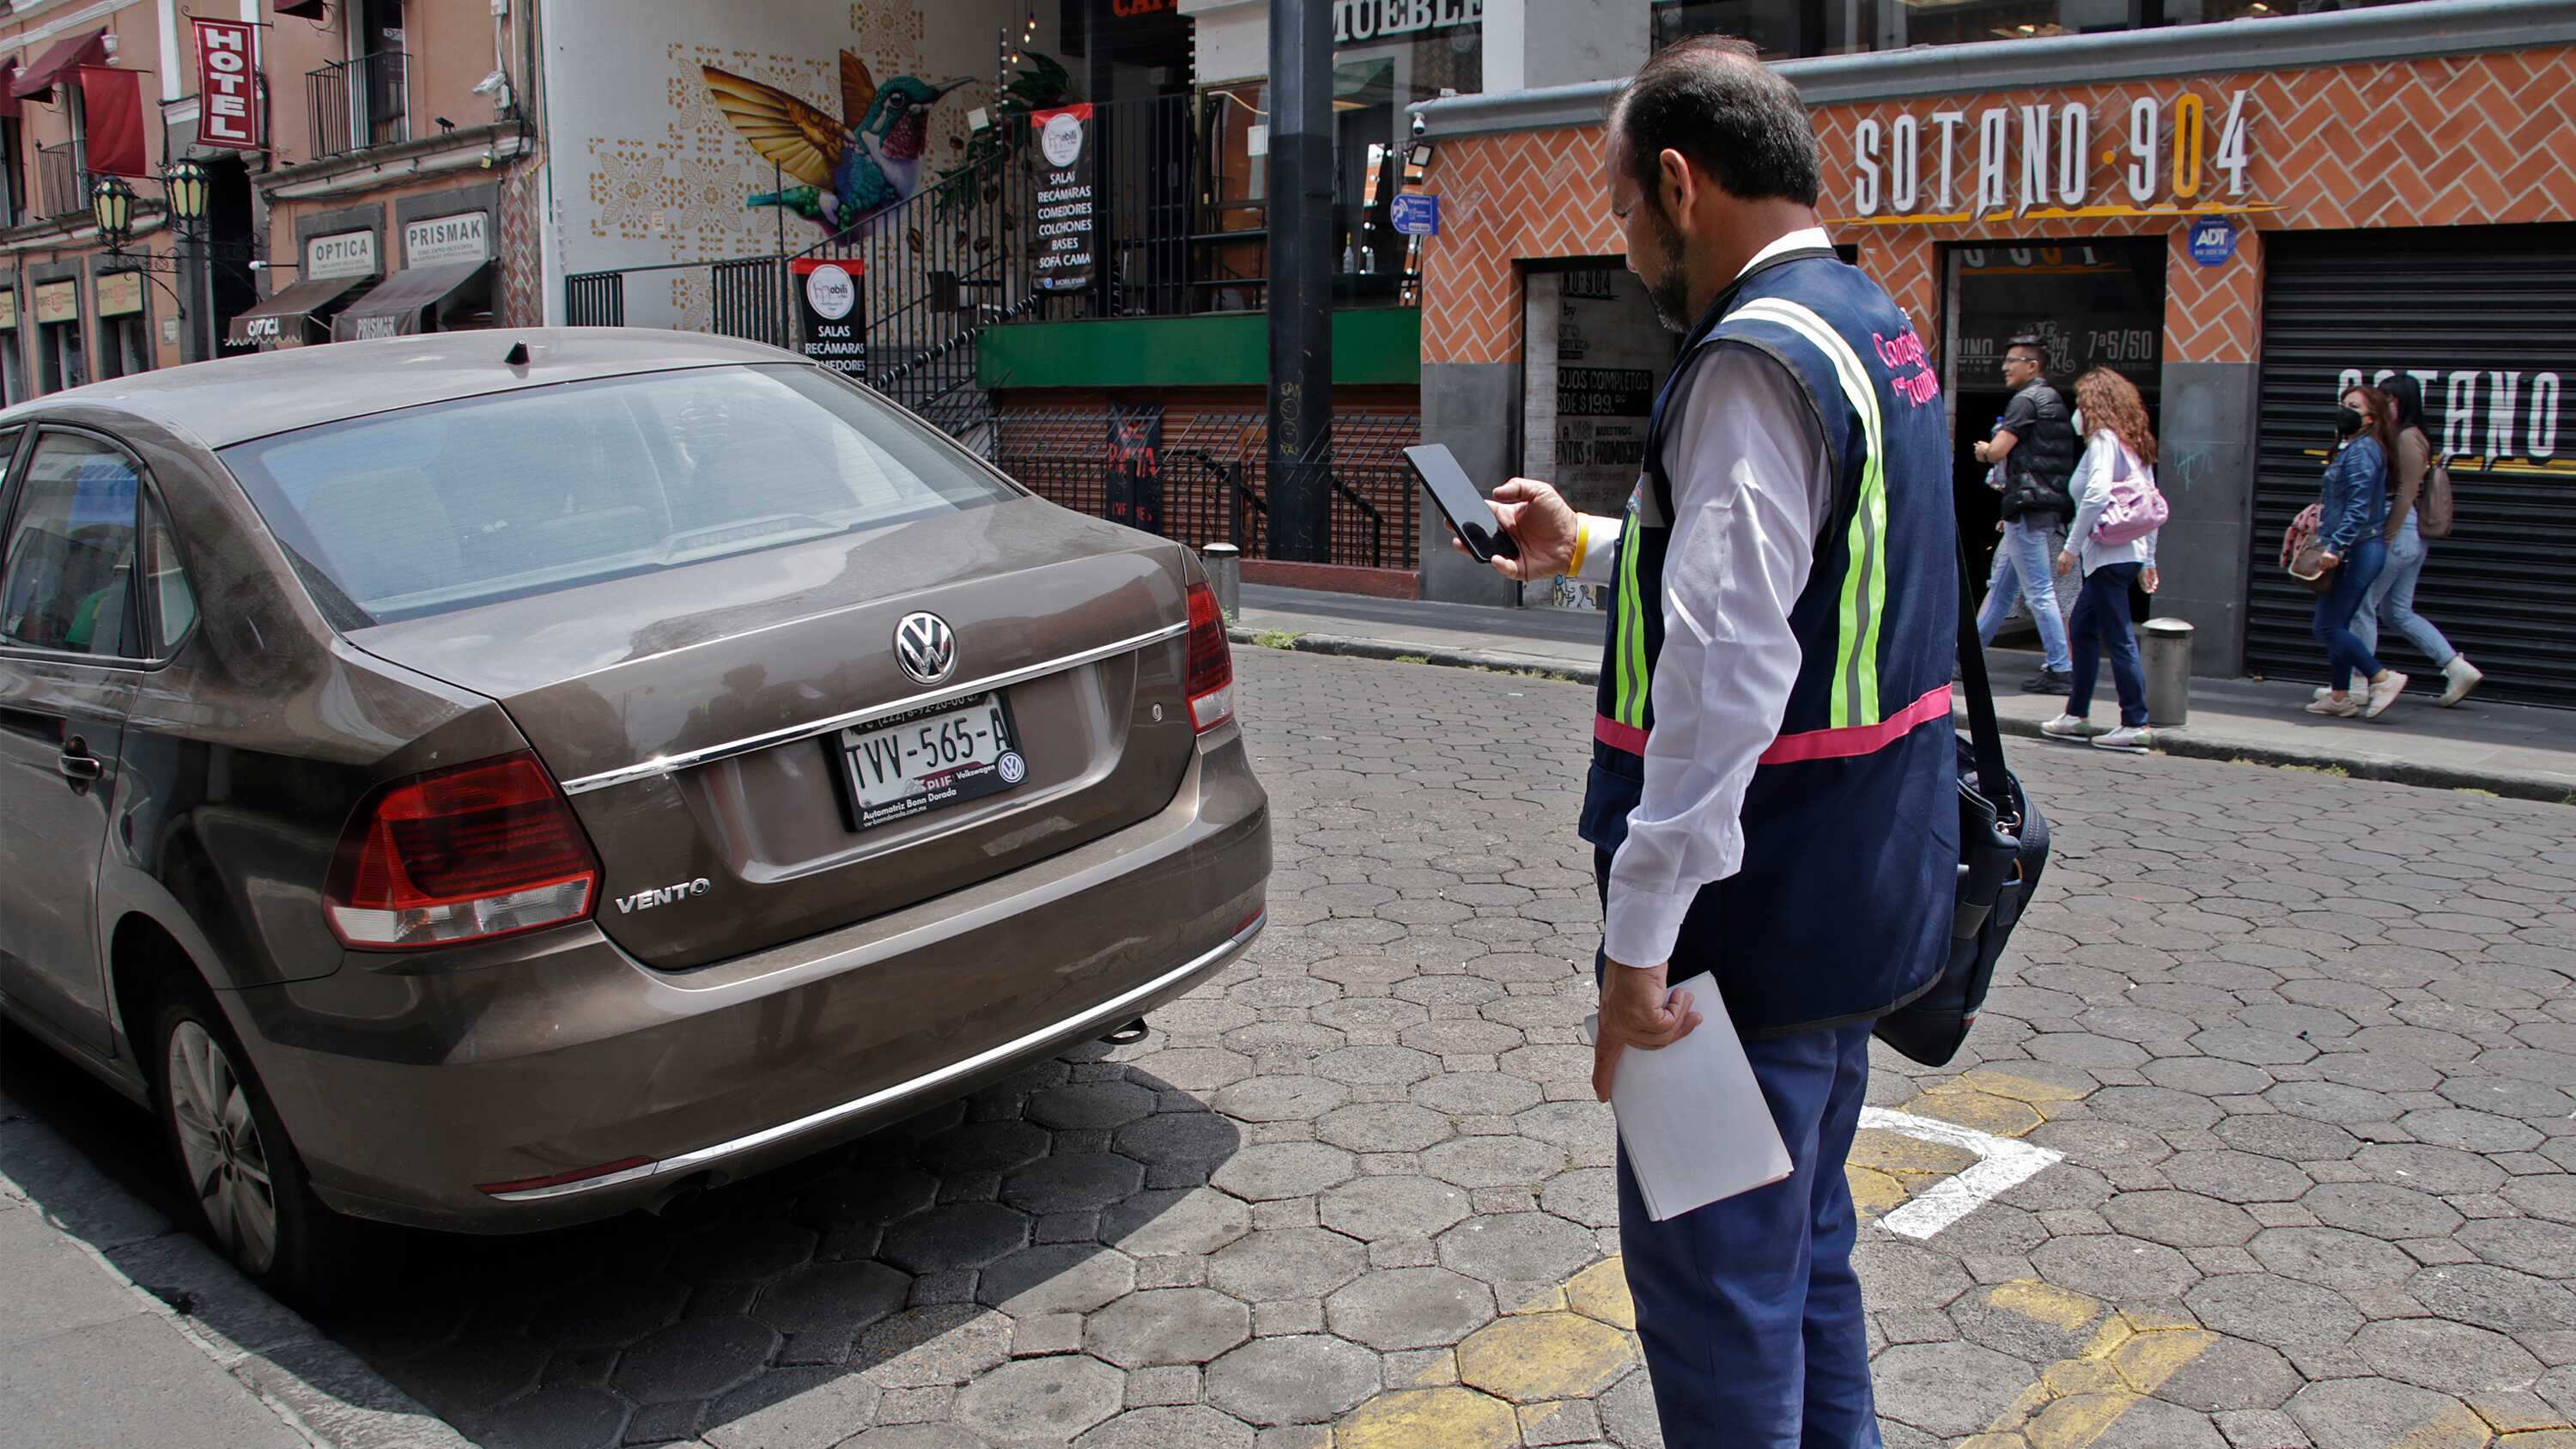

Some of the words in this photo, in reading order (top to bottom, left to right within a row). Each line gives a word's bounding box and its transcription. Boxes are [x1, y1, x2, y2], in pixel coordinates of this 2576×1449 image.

[204, 27, 246, 139] HOTEL
[1855, 100, 2088, 220] SOTANO
[2129, 90, 2248, 202] 904
[1050, 171, 1076, 185] SALAS
[1037, 202, 1092, 220] COMEDORES
[410, 219, 482, 247] PRISMAK
[1038, 219, 1092, 235] COLCHONES
[1051, 237, 1078, 251] BASES
[2196, 228, 2228, 247] ADT
[316, 239, 368, 261] OPTICA
[1039, 253, 1062, 269] SOFÁ
[1063, 253, 1091, 266] CAMA
[818, 326, 851, 338] SALAS
[805, 341, 865, 355] RECÁMARAS
[1589, 370, 1649, 392] COMPLETOS
[846, 707, 1012, 789] TVV-565-A
[956, 764, 996, 781] Volkswagen
[863, 802, 906, 821] Automotriz
[906, 796, 927, 809] Bonn
[927, 787, 957, 802] Dorada
[615, 878, 711, 914] VENTO
